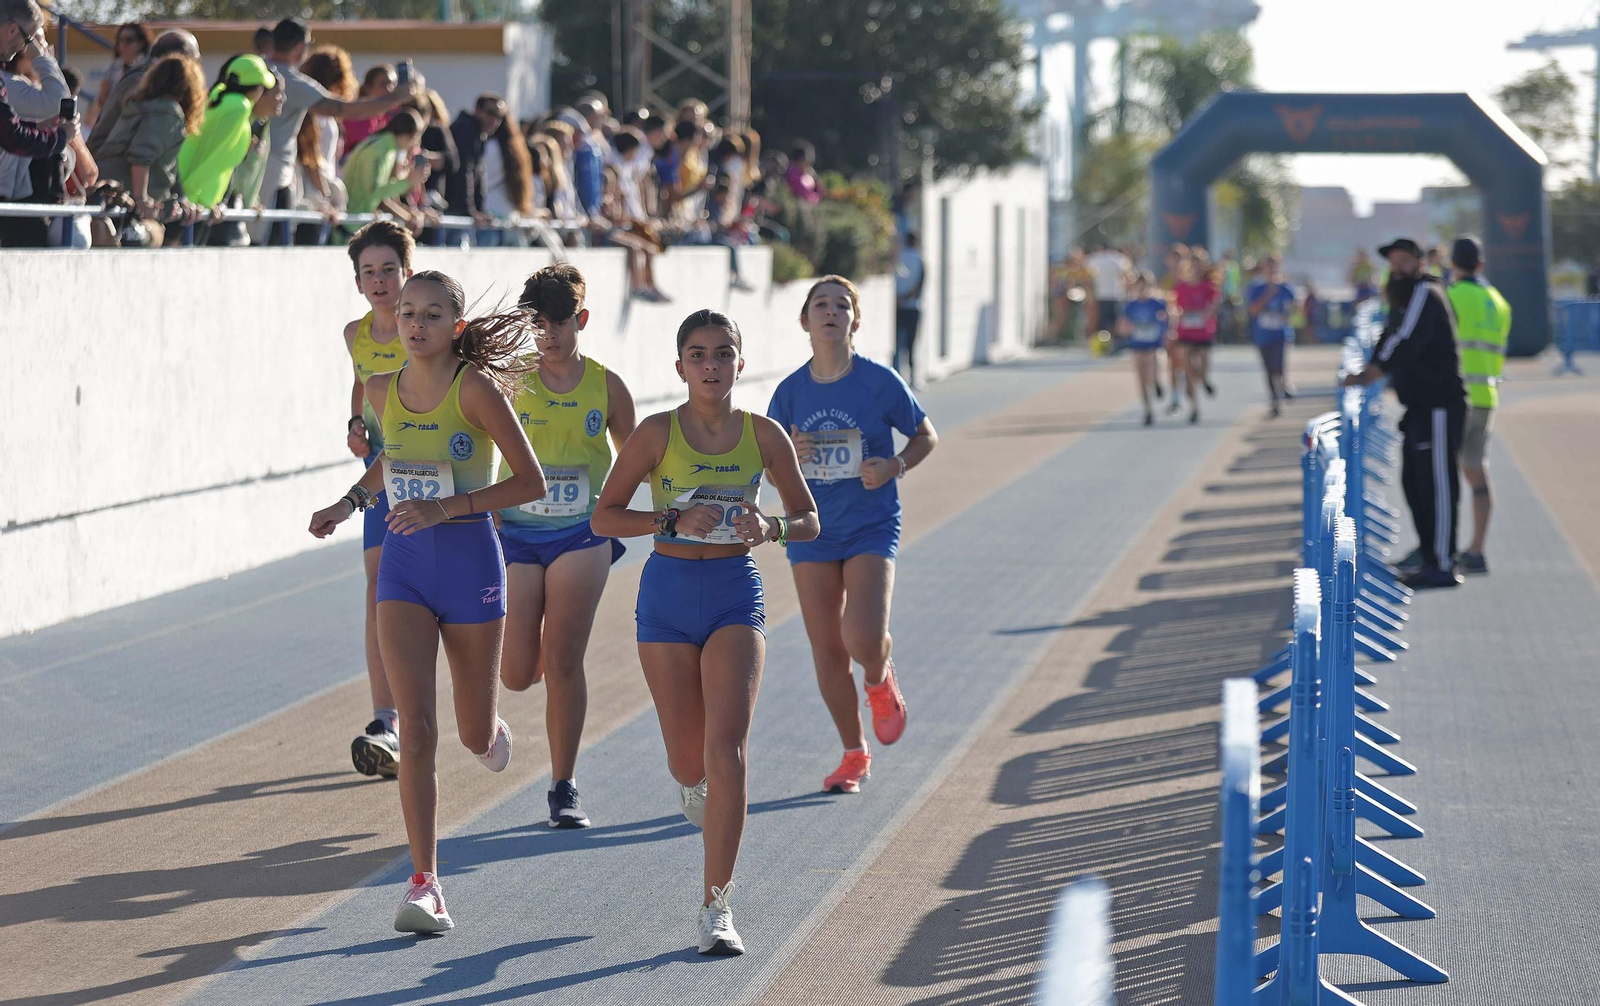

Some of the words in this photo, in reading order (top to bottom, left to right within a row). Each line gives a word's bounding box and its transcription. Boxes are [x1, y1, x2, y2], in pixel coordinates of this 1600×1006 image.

[418, 422, 438, 430] rasán
[801, 409, 828, 432] URBANA
[830, 408, 857, 428] CIUDAD
[810, 446, 850, 465] 370
[715, 463, 740, 472] rasán
[392, 477, 440, 500] 382
[540, 483, 579, 502] 19
